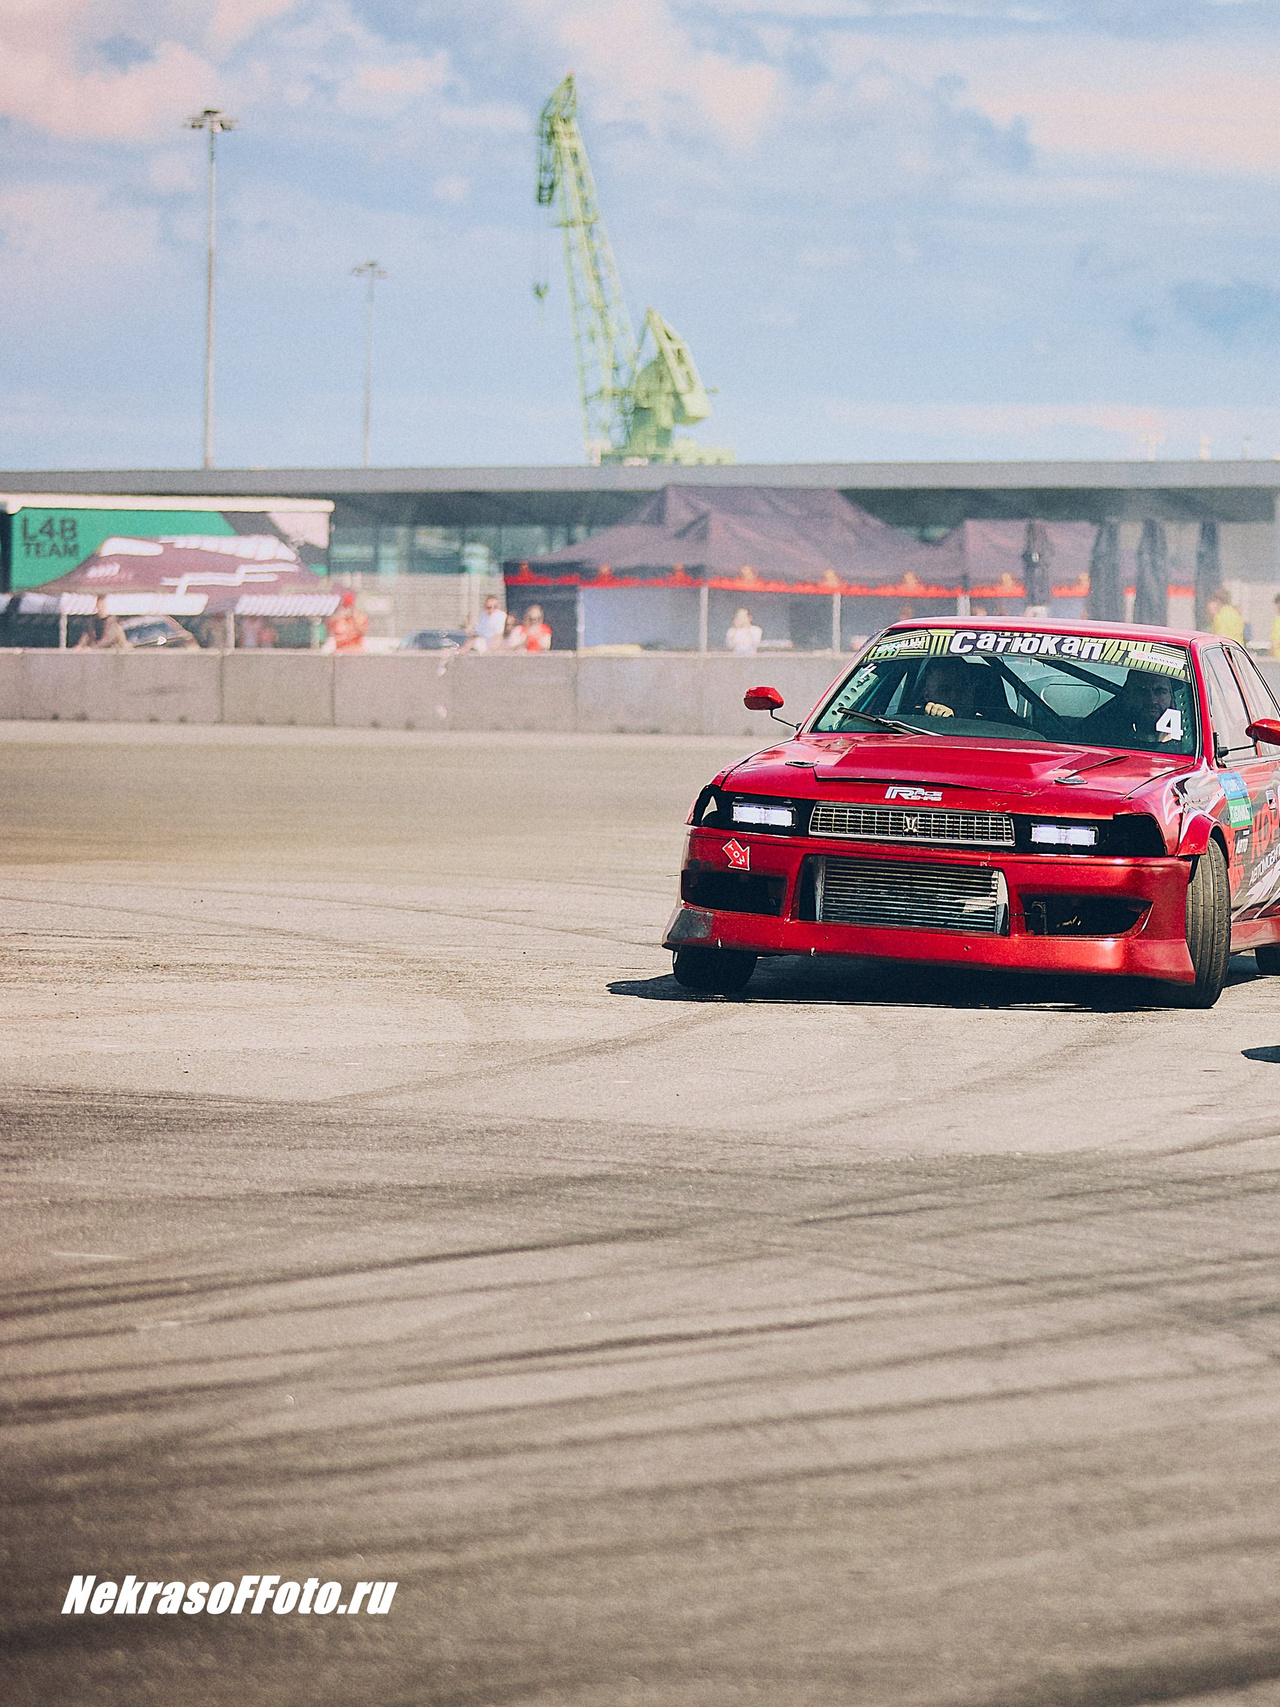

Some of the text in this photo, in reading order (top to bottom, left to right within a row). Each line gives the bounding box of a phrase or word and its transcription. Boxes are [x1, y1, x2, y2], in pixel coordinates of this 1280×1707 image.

[22, 518, 77, 541] L4B
[23, 542, 79, 558] TEAM
[1156, 708, 1184, 741] 4
[728, 844, 746, 865] TOW
